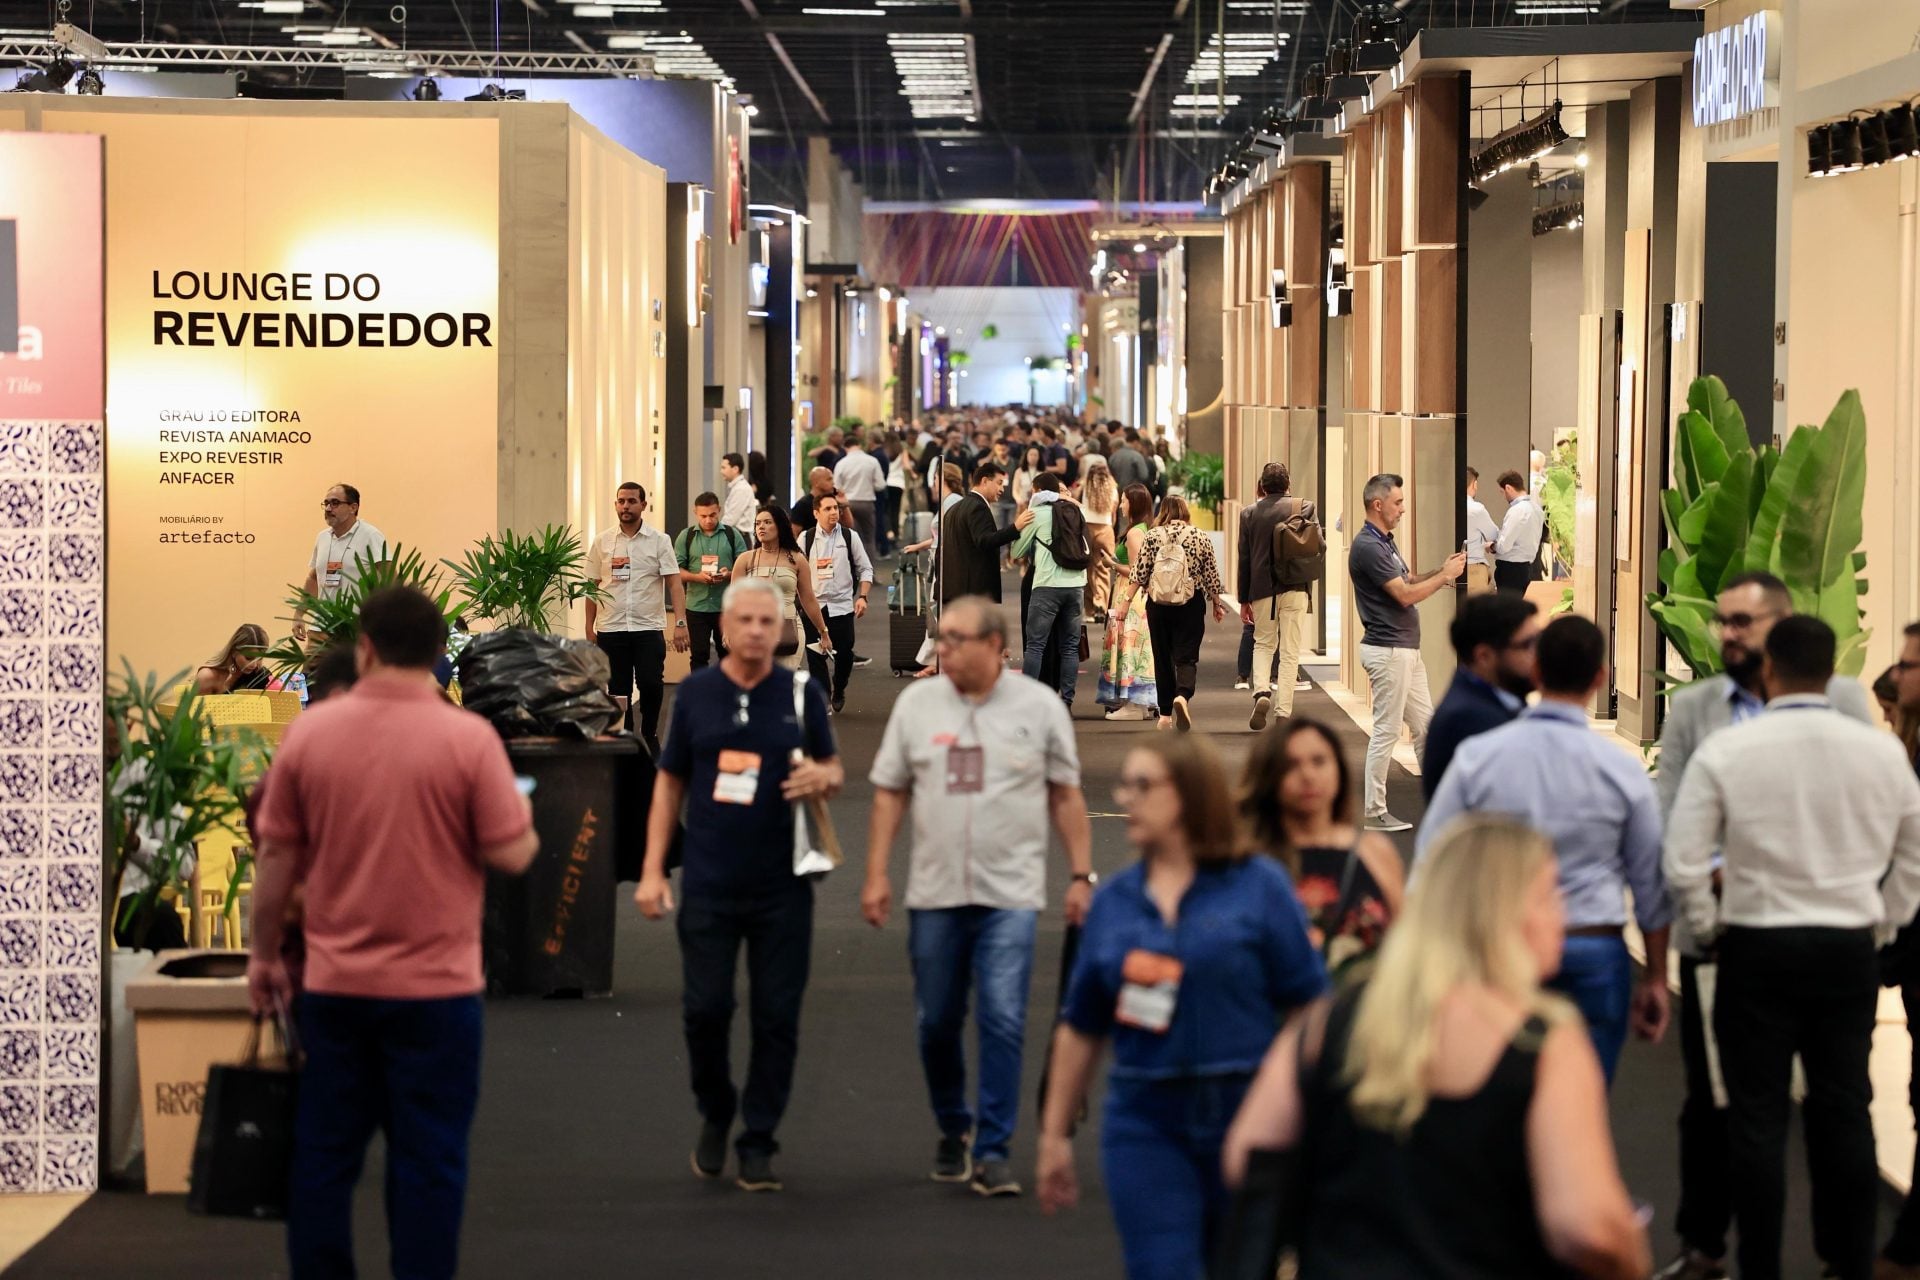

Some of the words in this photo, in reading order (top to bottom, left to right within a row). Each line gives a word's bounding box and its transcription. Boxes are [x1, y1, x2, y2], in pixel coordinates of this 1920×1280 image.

[153, 270, 312, 301] LOUNGE
[325, 272, 380, 301] DO
[153, 310, 493, 348] REVENDEDOR
[159, 409, 204, 422] GRAU
[208, 410, 227, 422] 10
[231, 410, 301, 423] EDITORA
[159, 430, 224, 443] REVISTA
[229, 431, 312, 444] ANAMACO
[159, 451, 202, 464] EXPO
[206, 452, 283, 464] REVESTIR
[159, 472, 235, 485] ANFACER
[159, 514, 211, 524] MOBILIÁRIO
[212, 516, 224, 524] BY
[159, 530, 256, 544] artefacto
